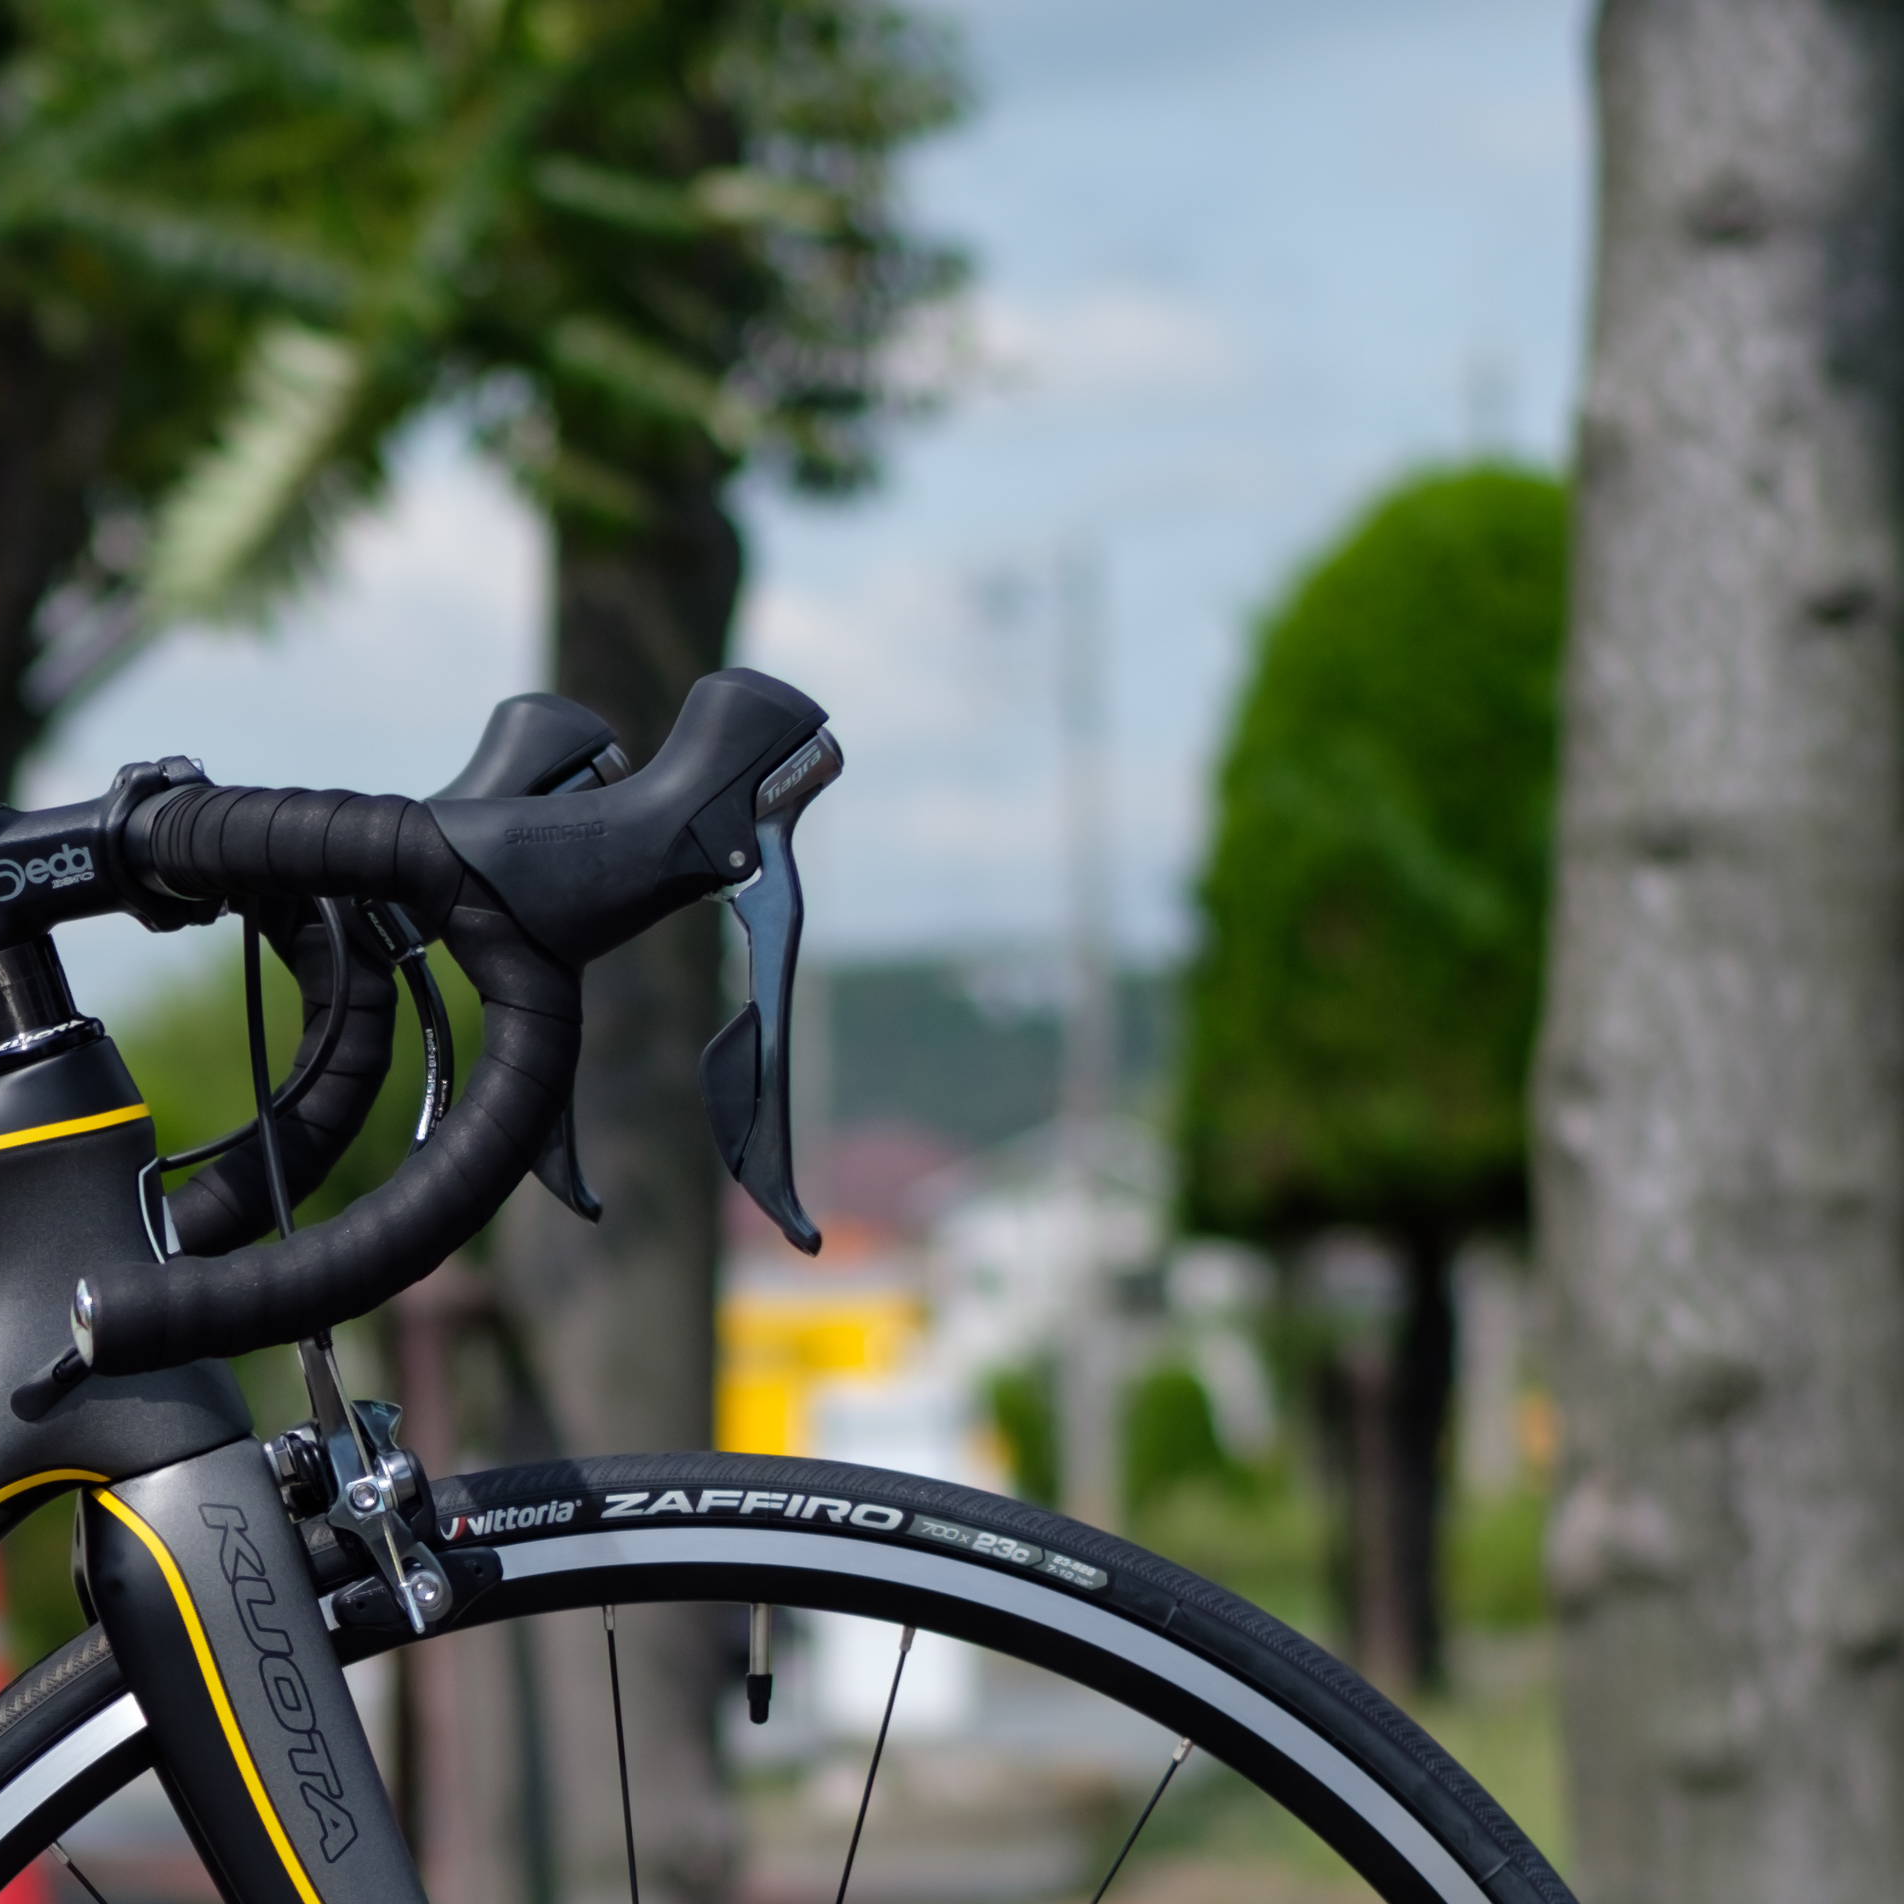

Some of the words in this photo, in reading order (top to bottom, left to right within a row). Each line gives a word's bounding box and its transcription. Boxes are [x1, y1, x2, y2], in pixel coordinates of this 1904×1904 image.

[763, 749, 822, 805] Tiagra
[505, 820, 607, 844] SHIMANO
[600, 1489, 904, 1532] ZAFFIRO
[921, 1521, 959, 1541] 700
[972, 1532, 1030, 1563] 23c
[199, 1502, 359, 1863] KUOTA
